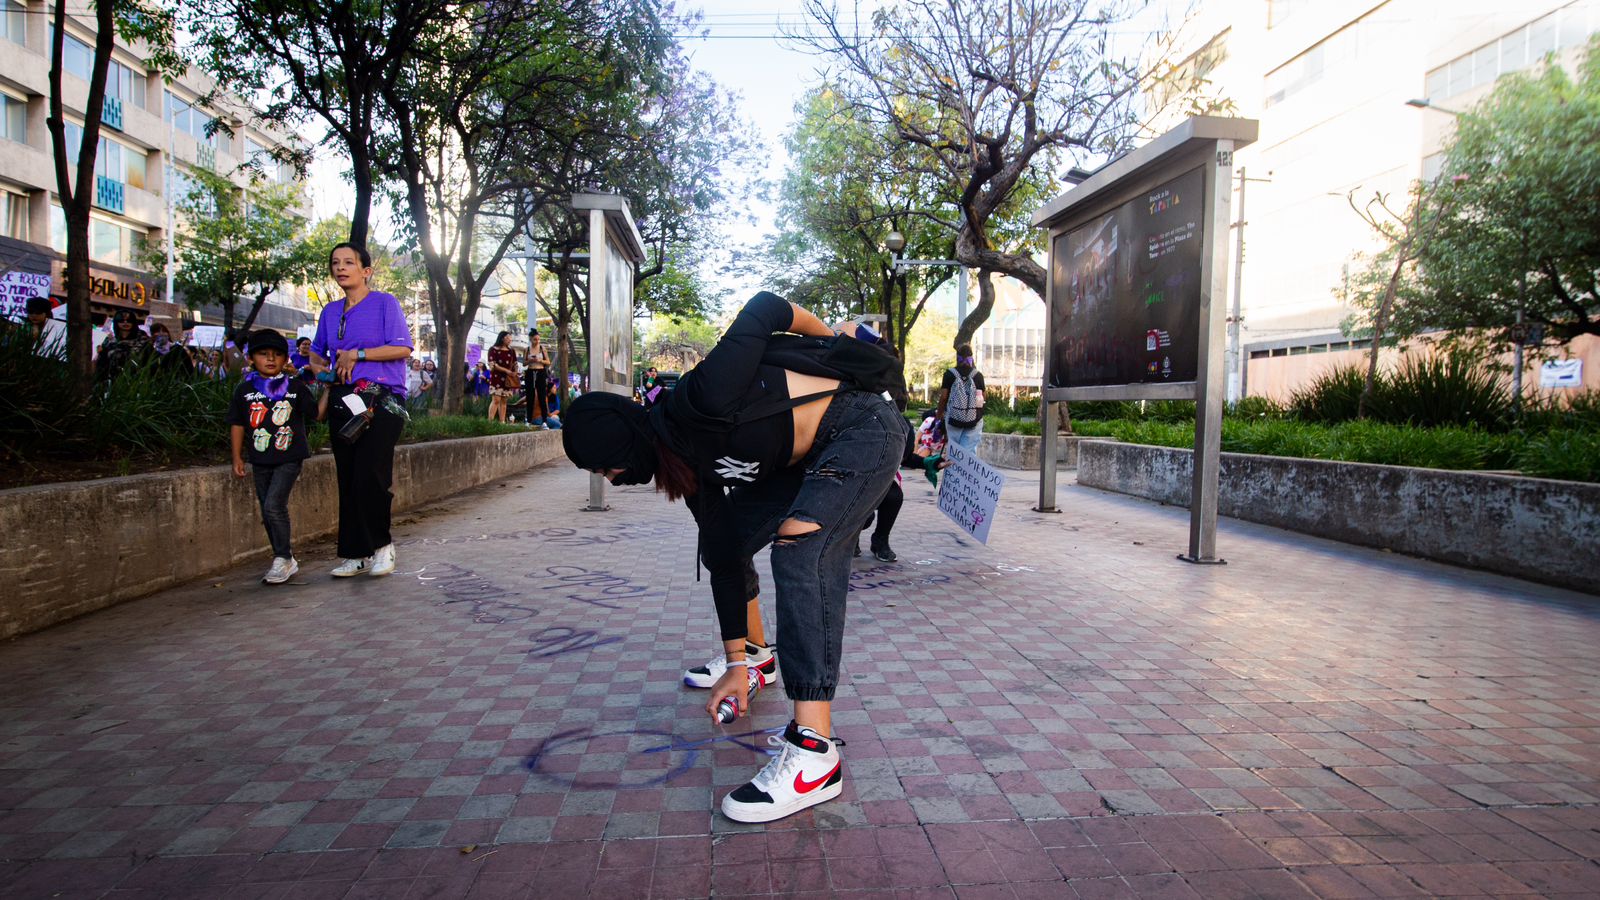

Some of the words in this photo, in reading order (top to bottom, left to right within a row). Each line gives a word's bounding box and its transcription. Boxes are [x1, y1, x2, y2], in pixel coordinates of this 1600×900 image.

[1216, 151, 1233, 167] 423
[949, 445, 965, 461] NO
[968, 456, 1002, 486] PIENSO
[943, 480, 986, 517] HERMANAS
[944, 469, 960, 487] POR
[963, 484, 979, 501] MIS
[984, 485, 999, 502] MAS
[941, 487, 958, 506] VOY
[961, 505, 967, 516] A
